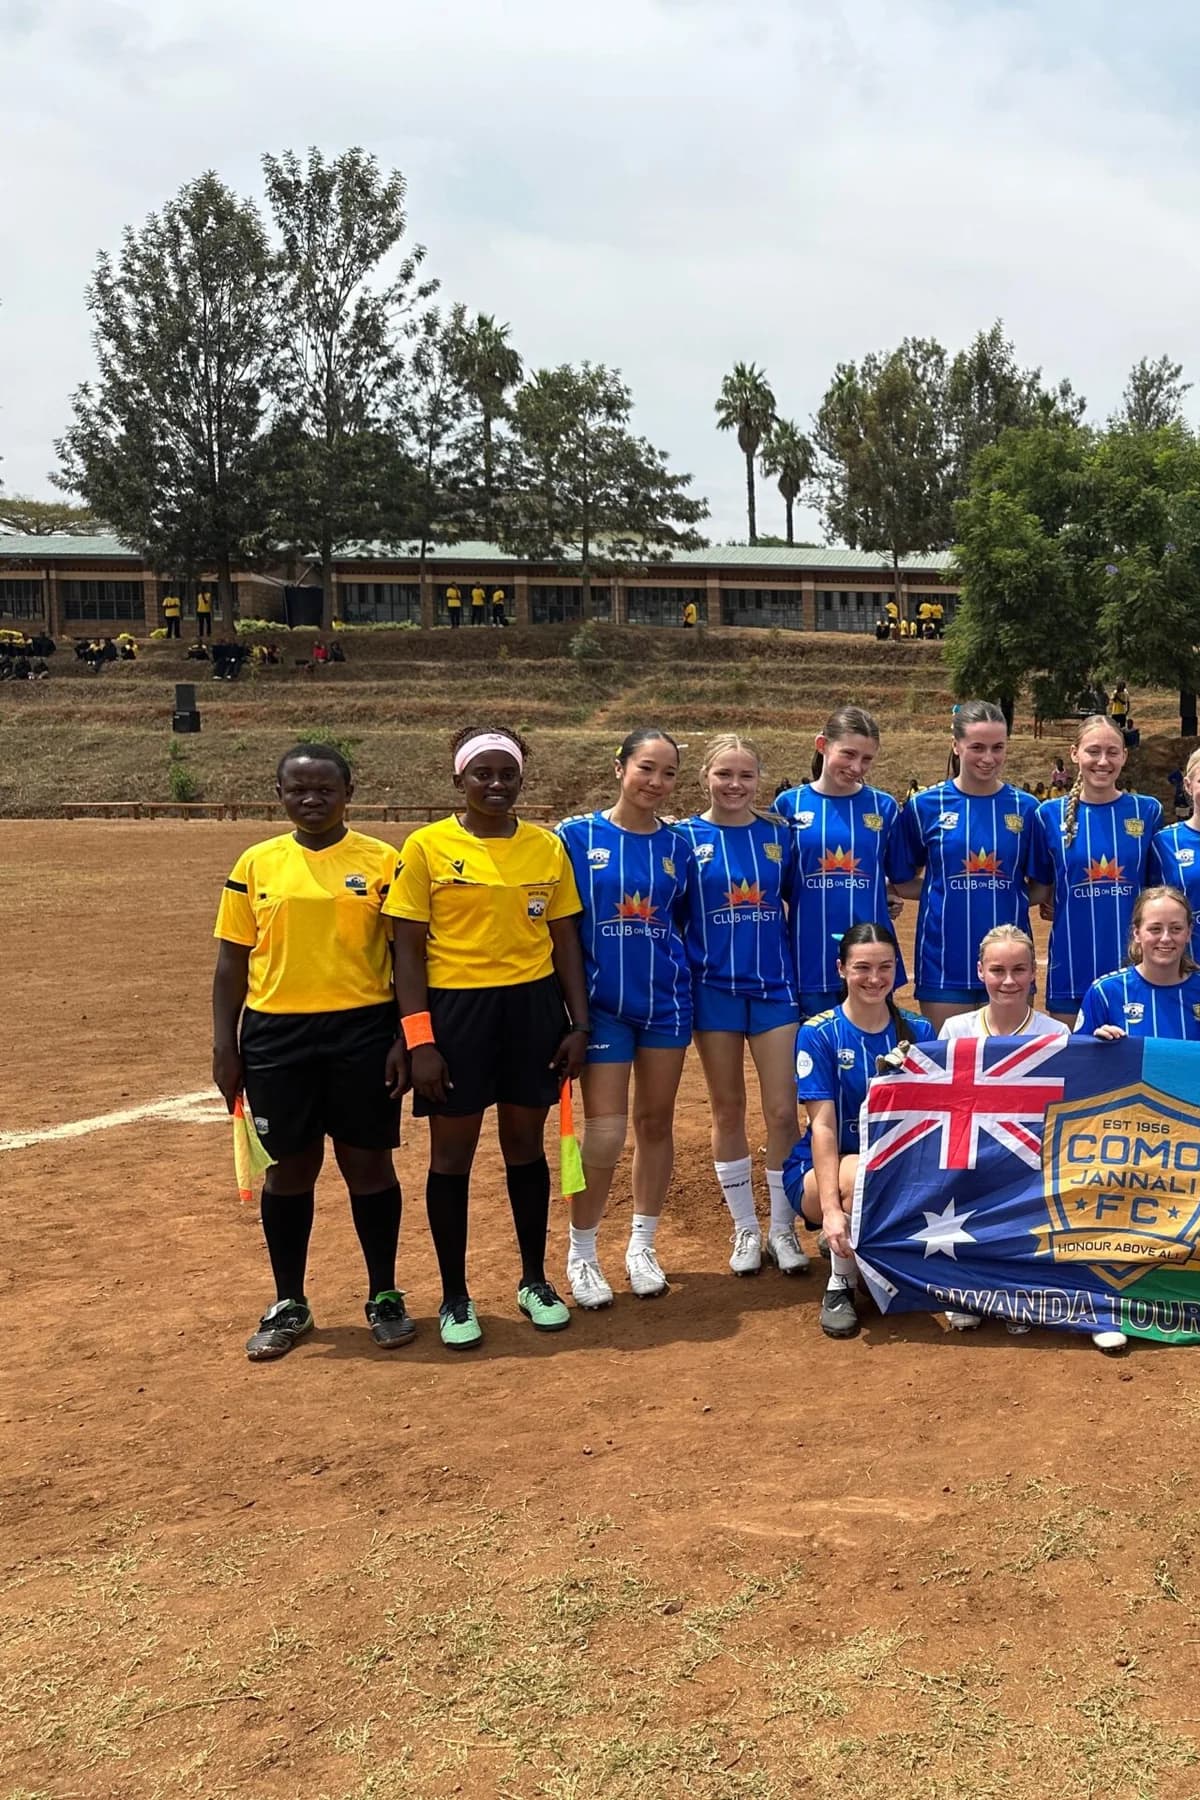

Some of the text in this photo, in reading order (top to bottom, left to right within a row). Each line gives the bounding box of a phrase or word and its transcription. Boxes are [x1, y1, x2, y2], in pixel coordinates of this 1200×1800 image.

[806, 878, 833, 889] CLUB
[844, 878, 871, 889] EAST
[950, 879, 978, 890] CLUB
[988, 879, 1013, 890] EAST
[1073, 886, 1101, 898] CLUB
[1110, 886, 1134, 896] EAST
[713, 912, 741, 925] CLUB
[752, 911, 777, 922] EAST
[601, 925, 633, 937] CLUB
[1102, 1119, 1171, 1134] EST 1956
[1070, 1169, 1196, 1195] JANNALI
[1057, 1241, 1112, 1253] HONOUR
[1114, 1243, 1156, 1257] ABOVE
